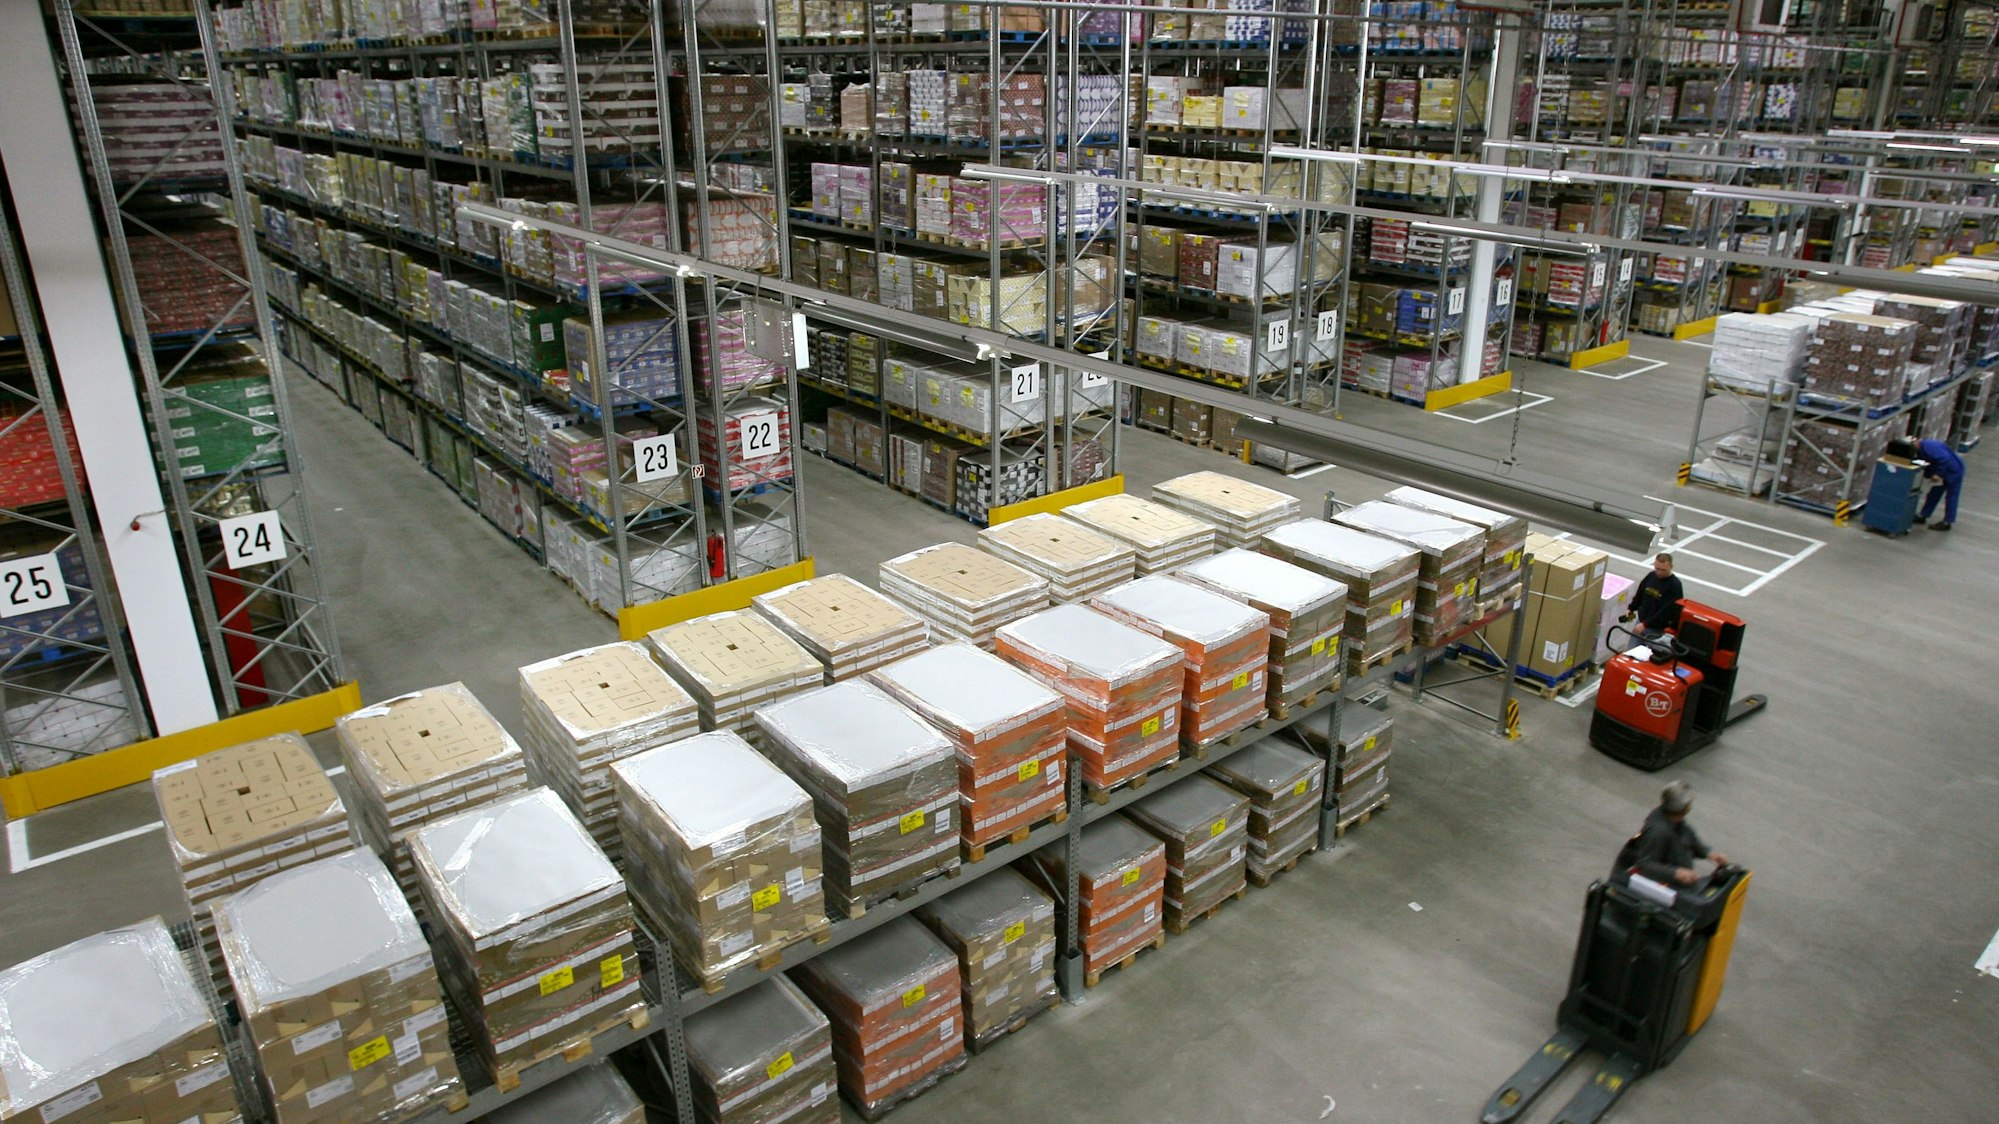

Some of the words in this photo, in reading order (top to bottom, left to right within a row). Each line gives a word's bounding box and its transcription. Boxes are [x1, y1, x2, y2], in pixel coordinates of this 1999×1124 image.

[1453, 293, 1462, 310] 17
[1500, 284, 1509, 301] 16
[1272, 325, 1284, 346] 19
[1321, 316, 1333, 336] 18
[1017, 372, 1033, 396] 21
[748, 422, 771, 450] 22
[643, 443, 669, 473] 23
[233, 523, 272, 558] 24
[4, 566, 52, 605] 25
[1650, 697, 1669, 711] BT
